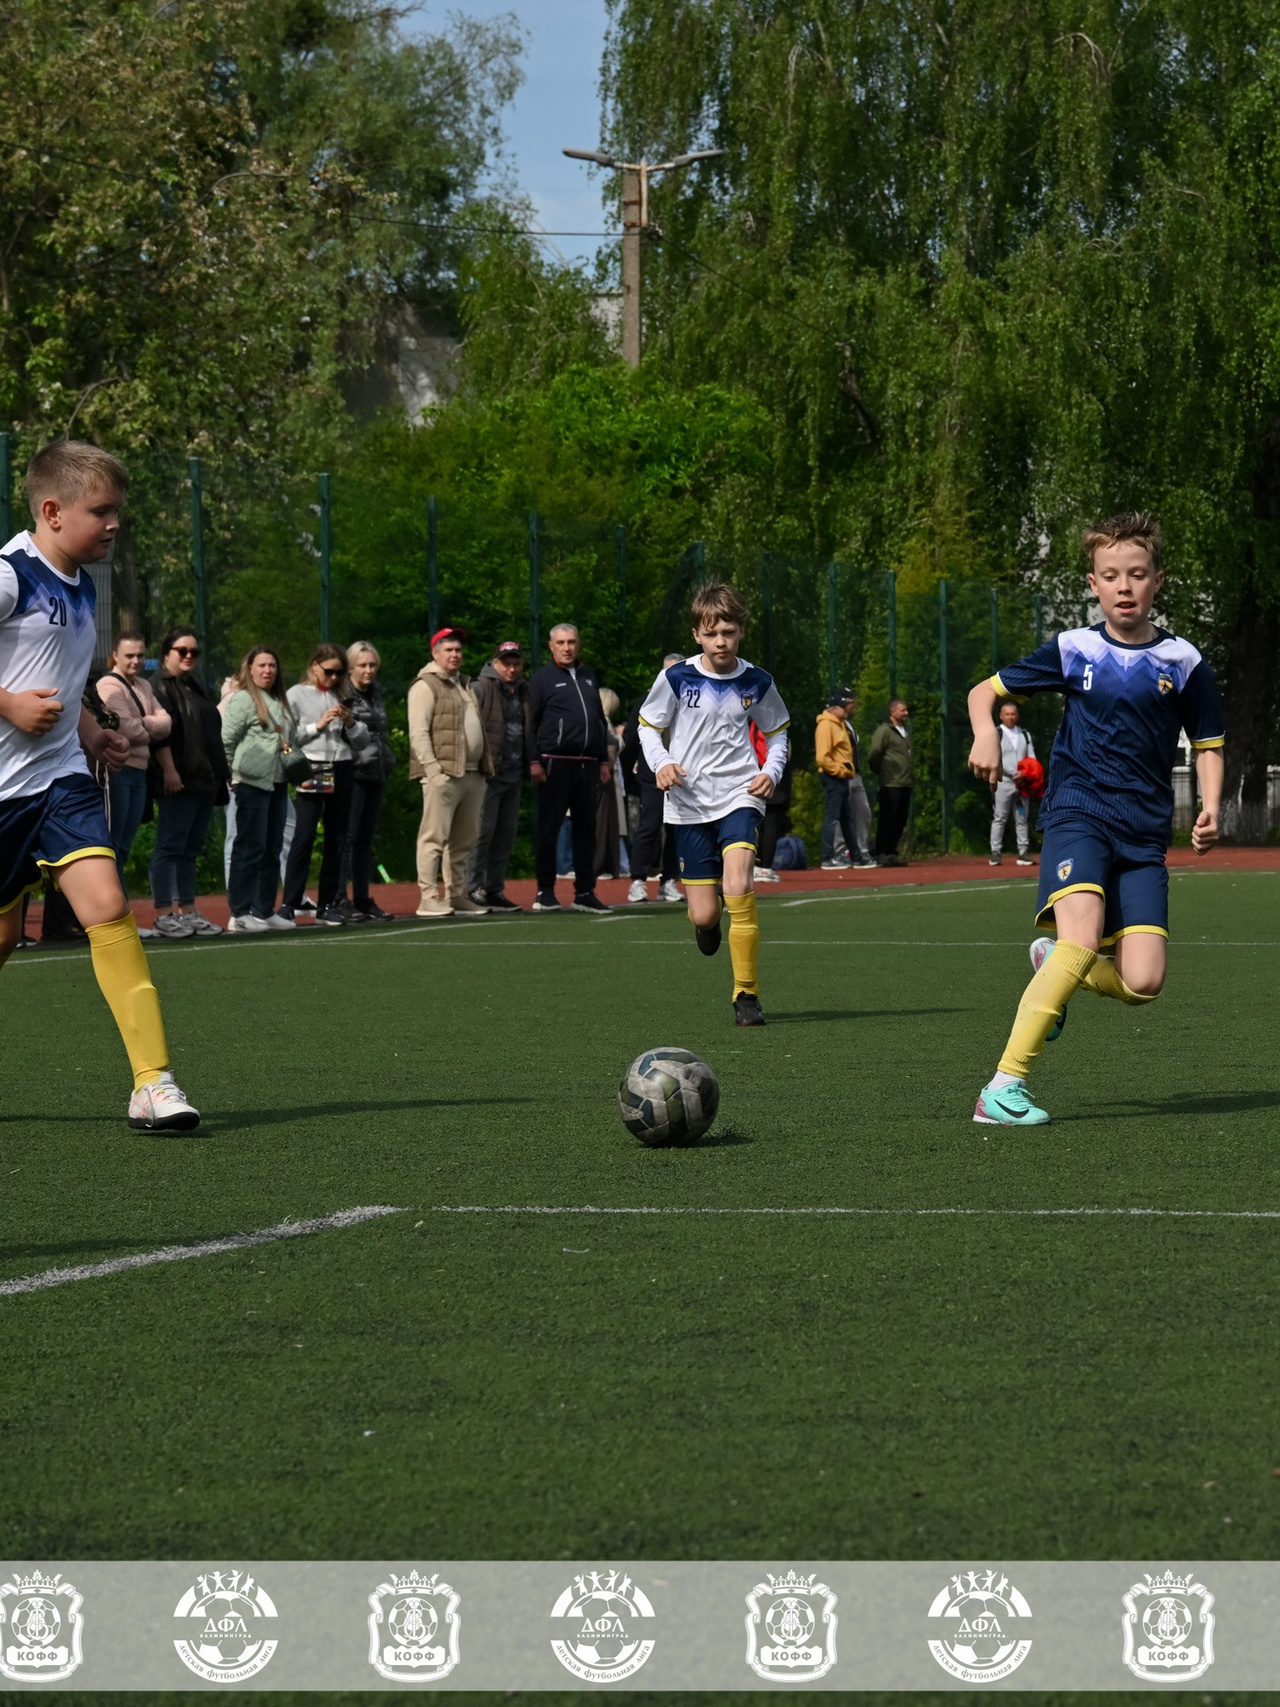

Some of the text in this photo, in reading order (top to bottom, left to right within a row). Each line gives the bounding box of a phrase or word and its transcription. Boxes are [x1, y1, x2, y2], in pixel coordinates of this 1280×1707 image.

[48, 596, 67, 627] 20
[1082, 664, 1093, 691] 5
[686, 689, 700, 708] 22
